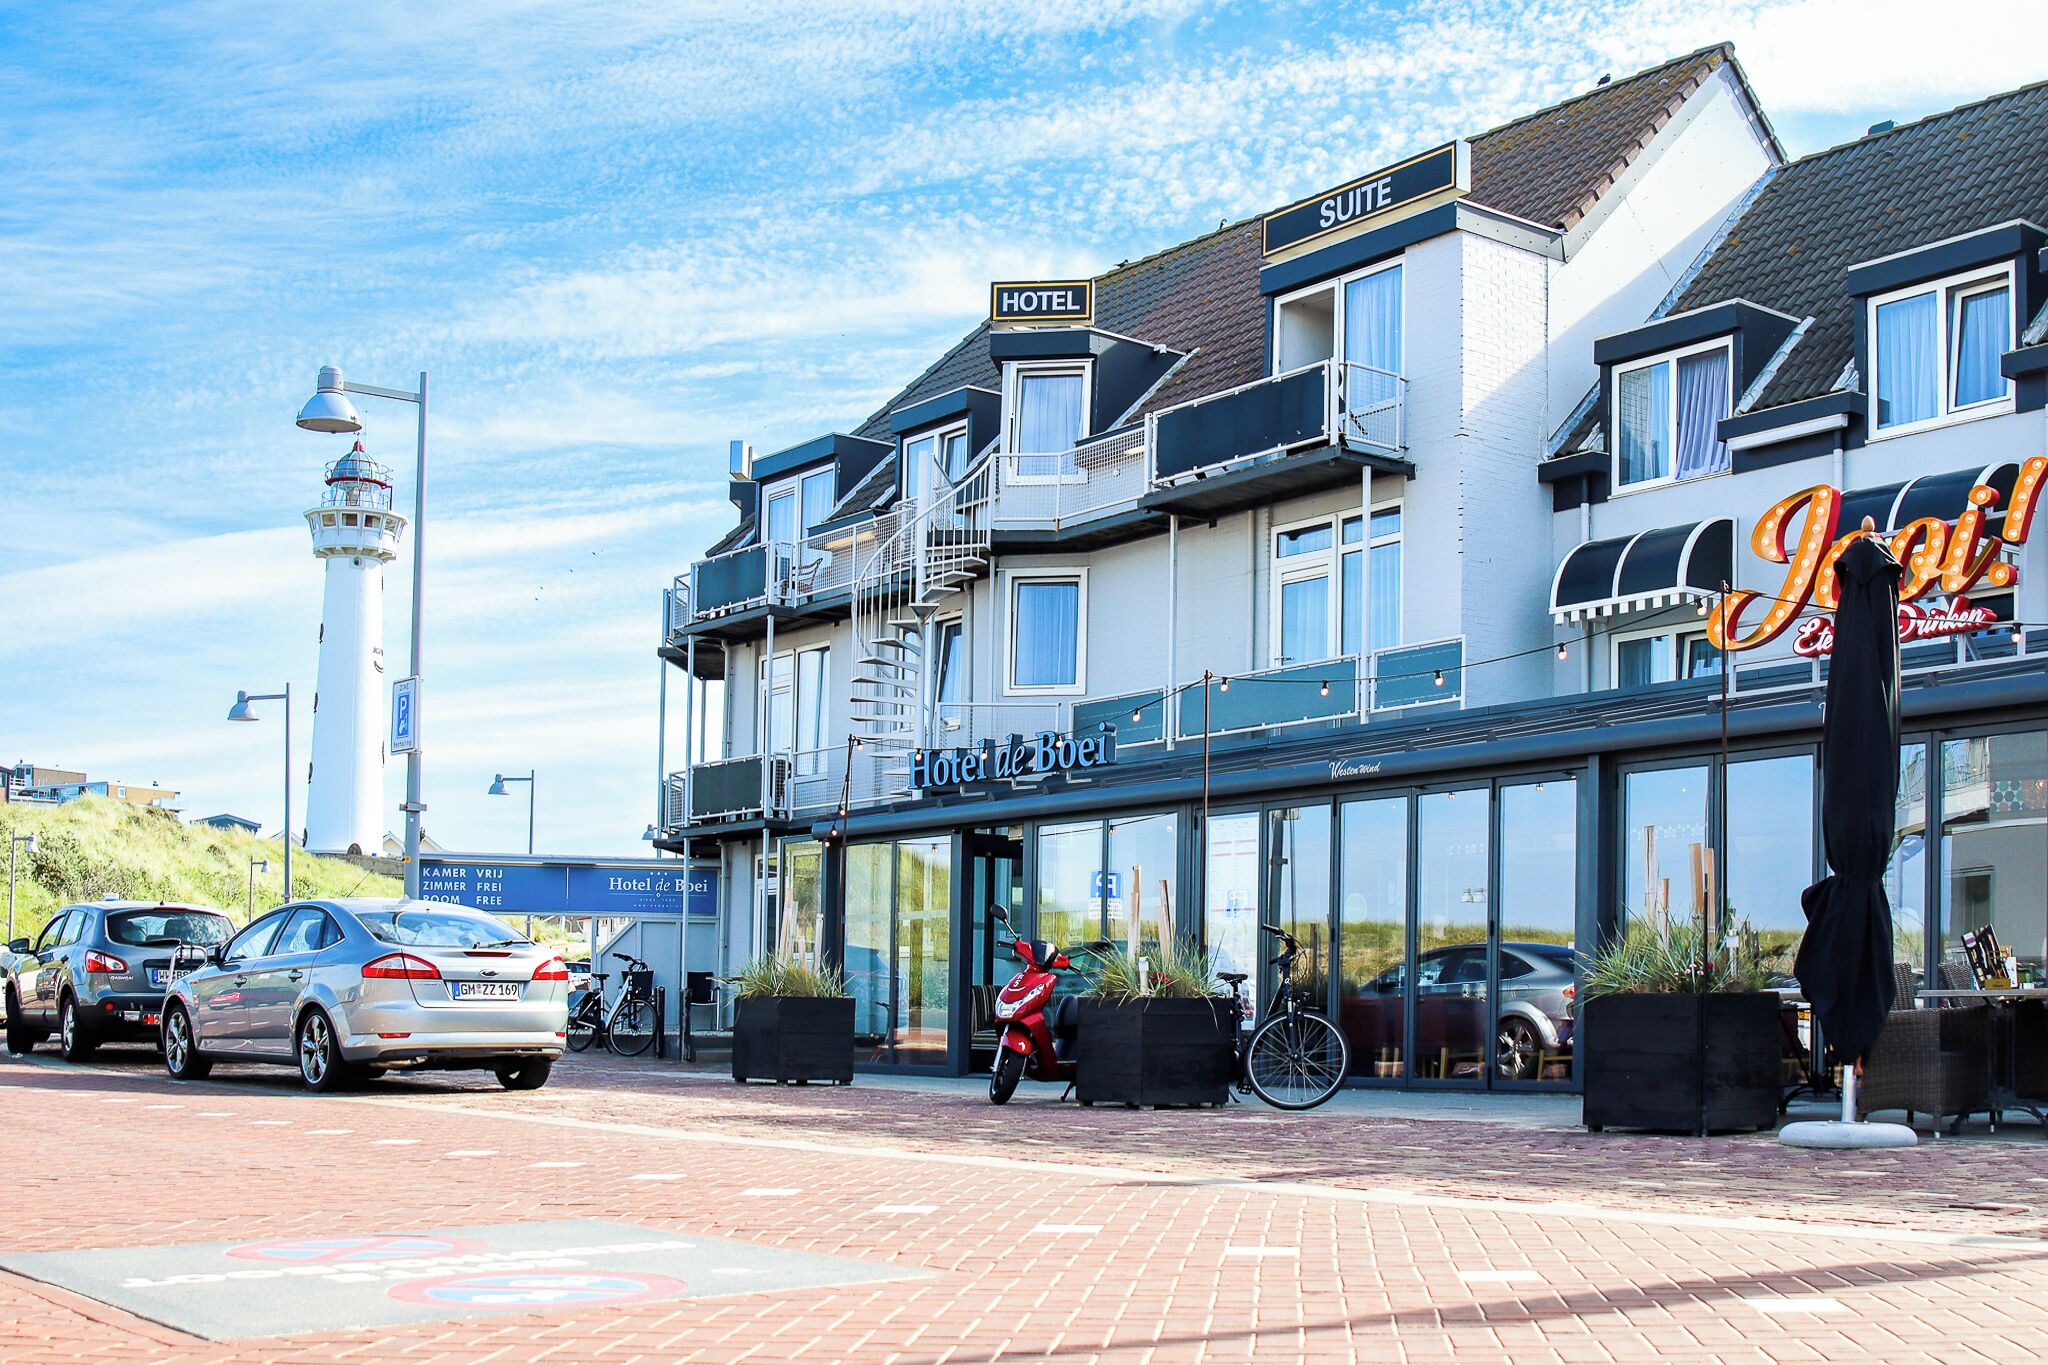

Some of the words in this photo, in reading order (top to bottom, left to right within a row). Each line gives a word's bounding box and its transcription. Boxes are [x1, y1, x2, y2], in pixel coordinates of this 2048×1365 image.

[1319, 176, 1392, 228] SUITE
[1002, 290, 1081, 312] HOTEL
[1793, 616, 1834, 656] Ete
[907, 738, 989, 789] Hotel
[995, 732, 1027, 778] de
[1033, 721, 1110, 773] Boei
[422, 867, 467, 878] KAMER
[475, 868, 503, 879] VRIJ
[422, 881, 467, 891] ZIMMER
[476, 882, 502, 892] FREI
[608, 877, 652, 891] Hotel
[655, 878, 671, 892] de
[475, 895, 502, 906] FREE
[460, 984, 476, 996] GM
[482, 984, 496, 996] ZZ
[498, 983, 518, 996] 169
